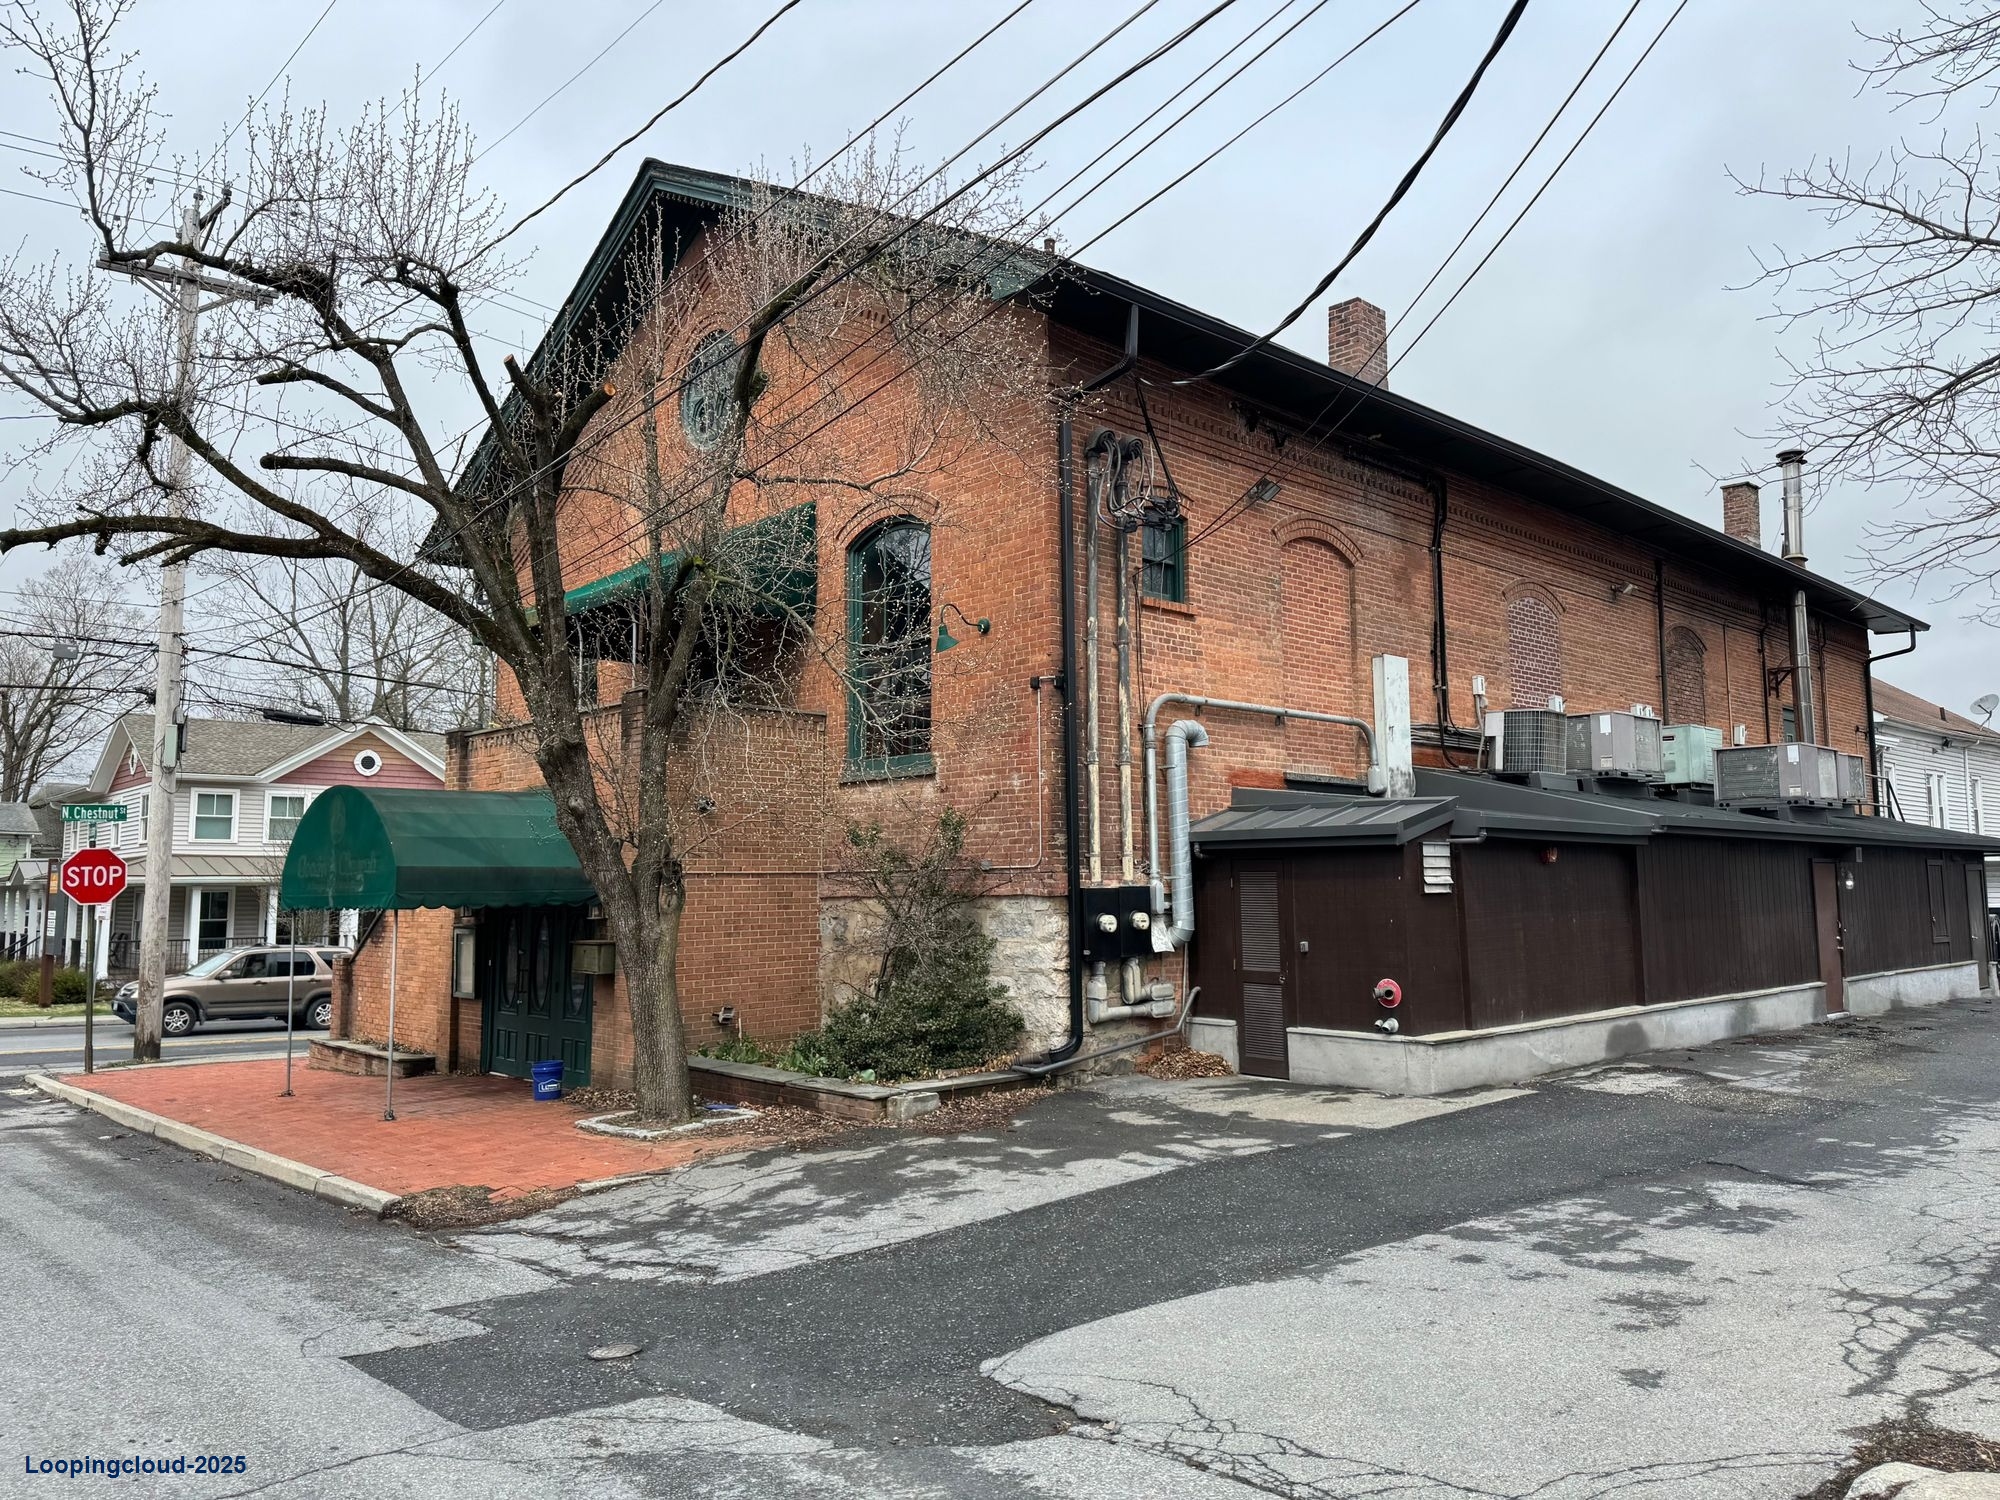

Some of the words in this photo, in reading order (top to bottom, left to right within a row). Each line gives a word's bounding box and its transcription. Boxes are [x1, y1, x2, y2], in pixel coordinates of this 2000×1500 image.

[62, 806, 72, 819] N.
[73, 806, 118, 819] Chestnut
[119, 807, 126, 815] St
[66, 865, 122, 887] STOP
